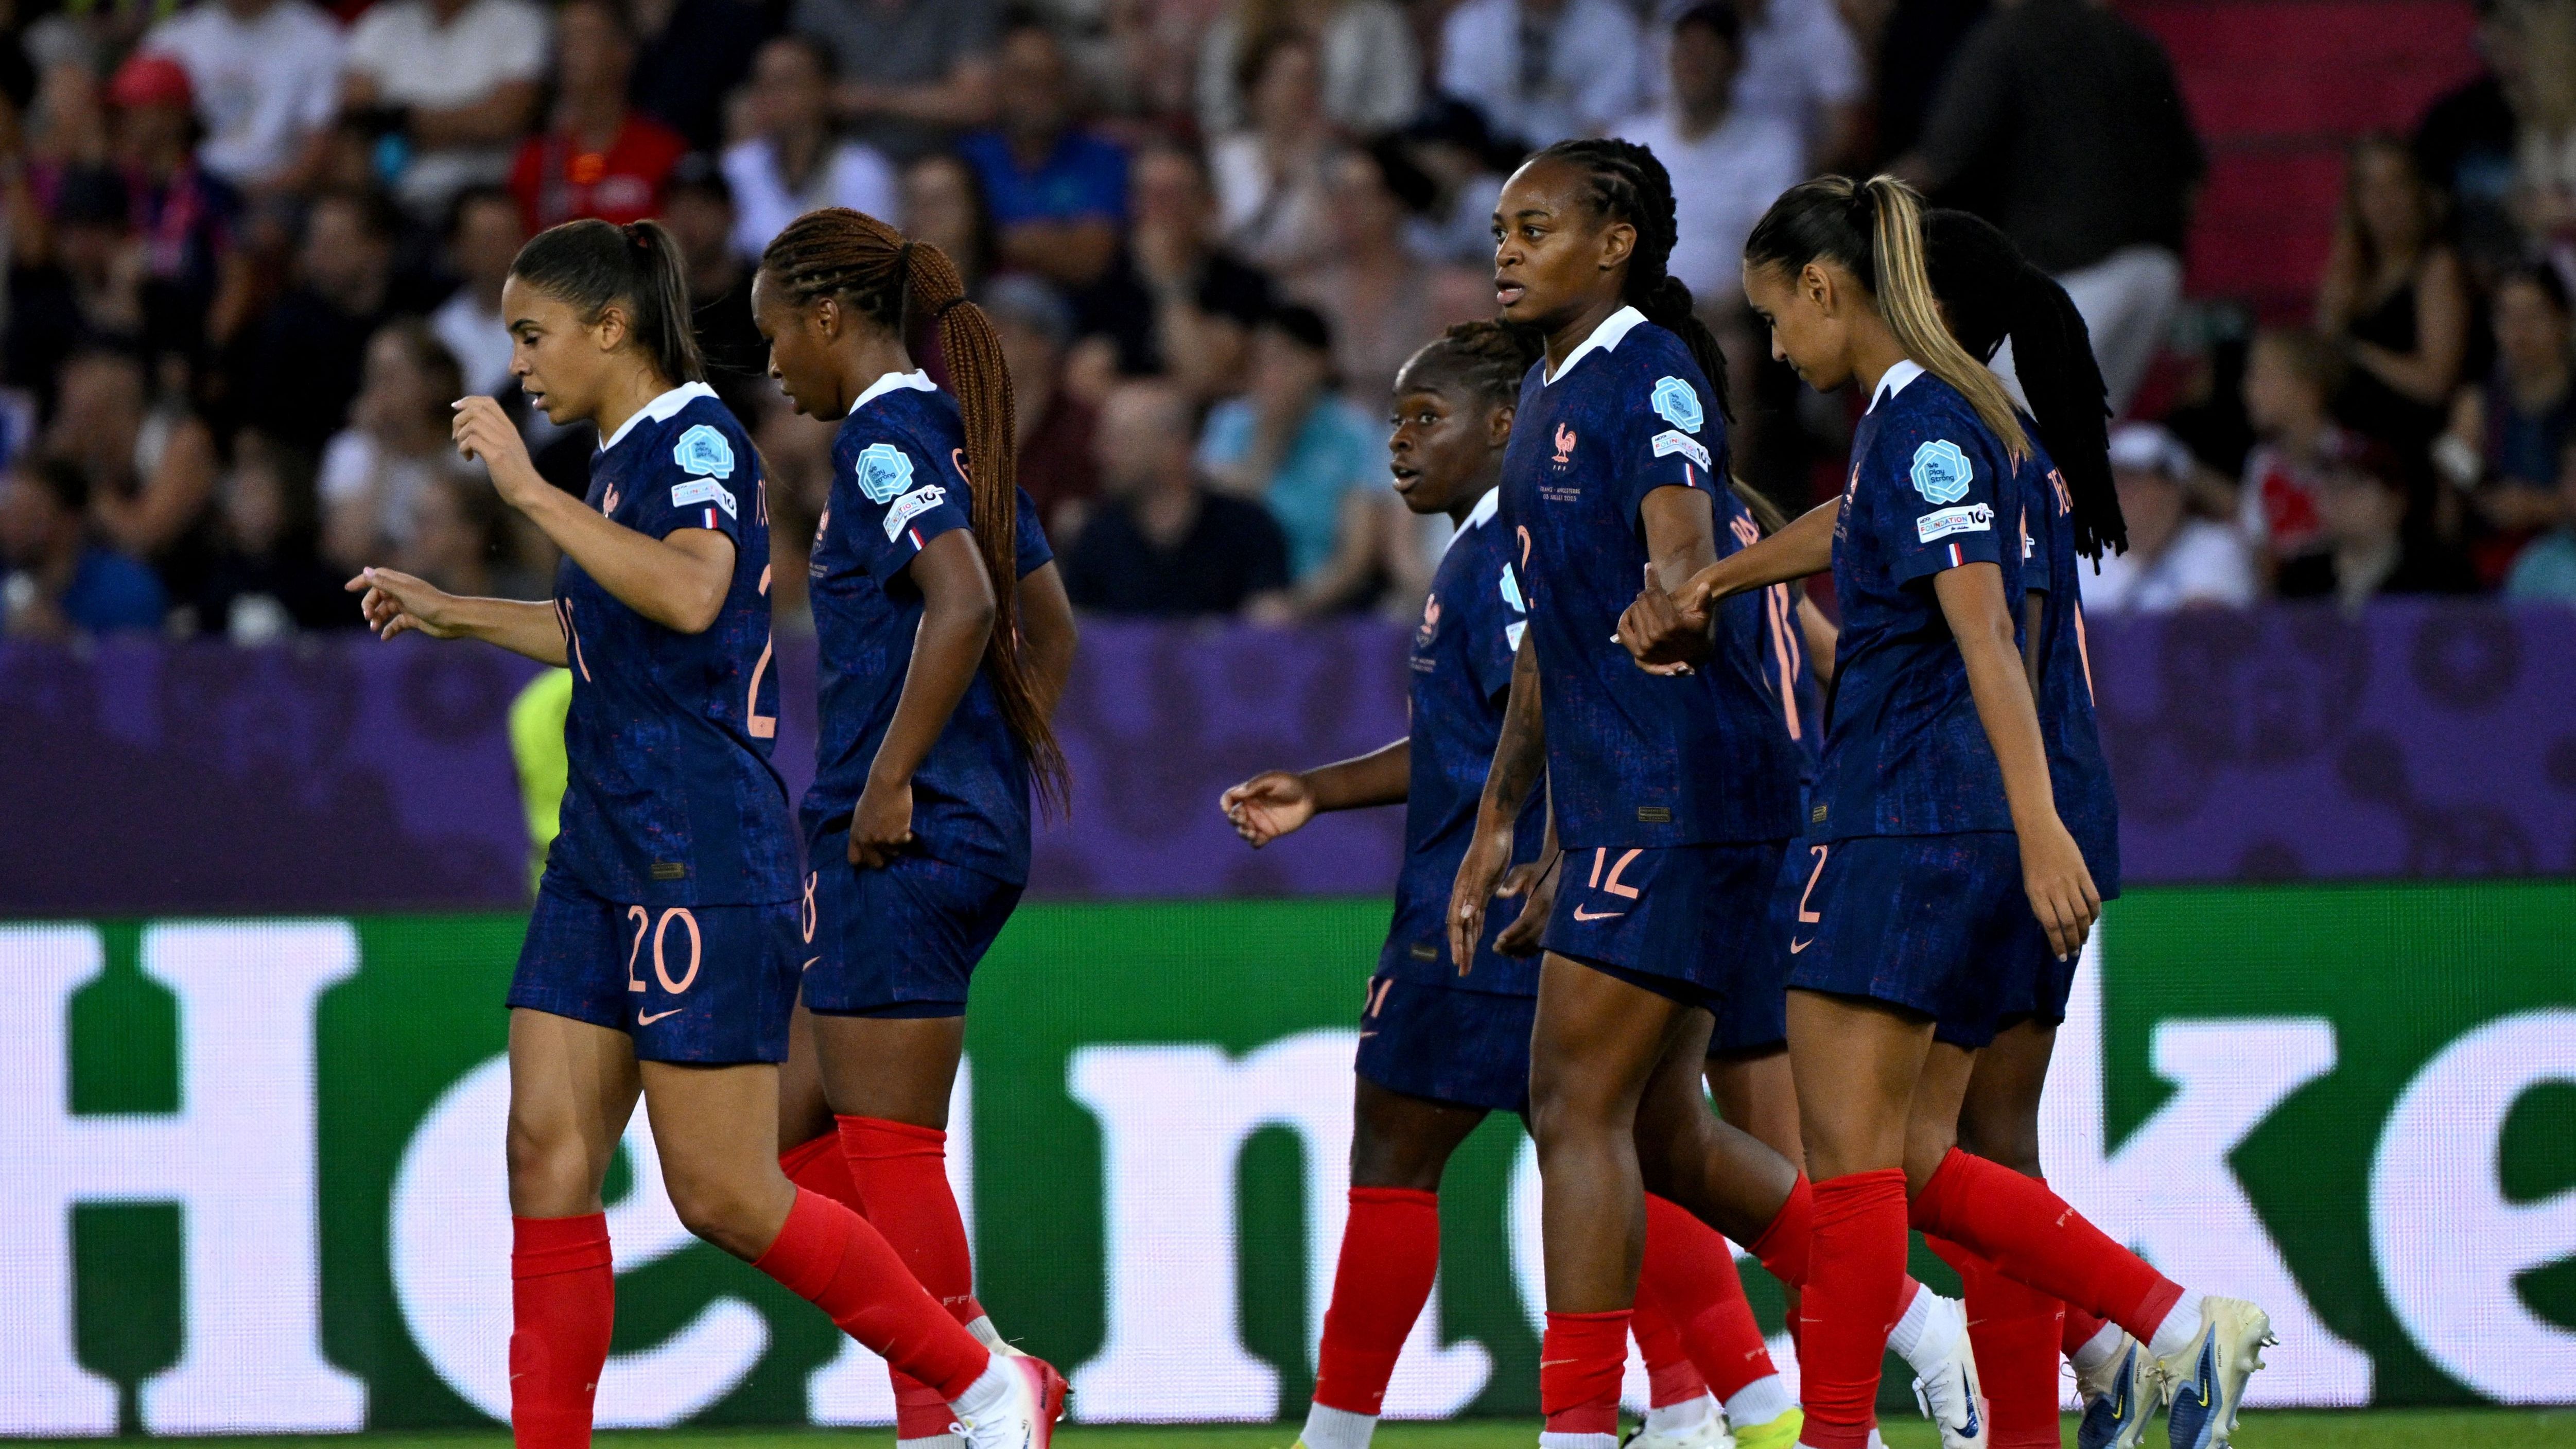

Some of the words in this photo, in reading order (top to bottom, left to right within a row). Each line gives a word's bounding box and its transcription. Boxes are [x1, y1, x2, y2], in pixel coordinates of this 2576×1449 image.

[1920, 516, 1968, 533] FOUNDATION
[1968, 511, 1987, 524] 10
[1799, 845, 1828, 923] 2
[628, 905, 701, 994] 20
